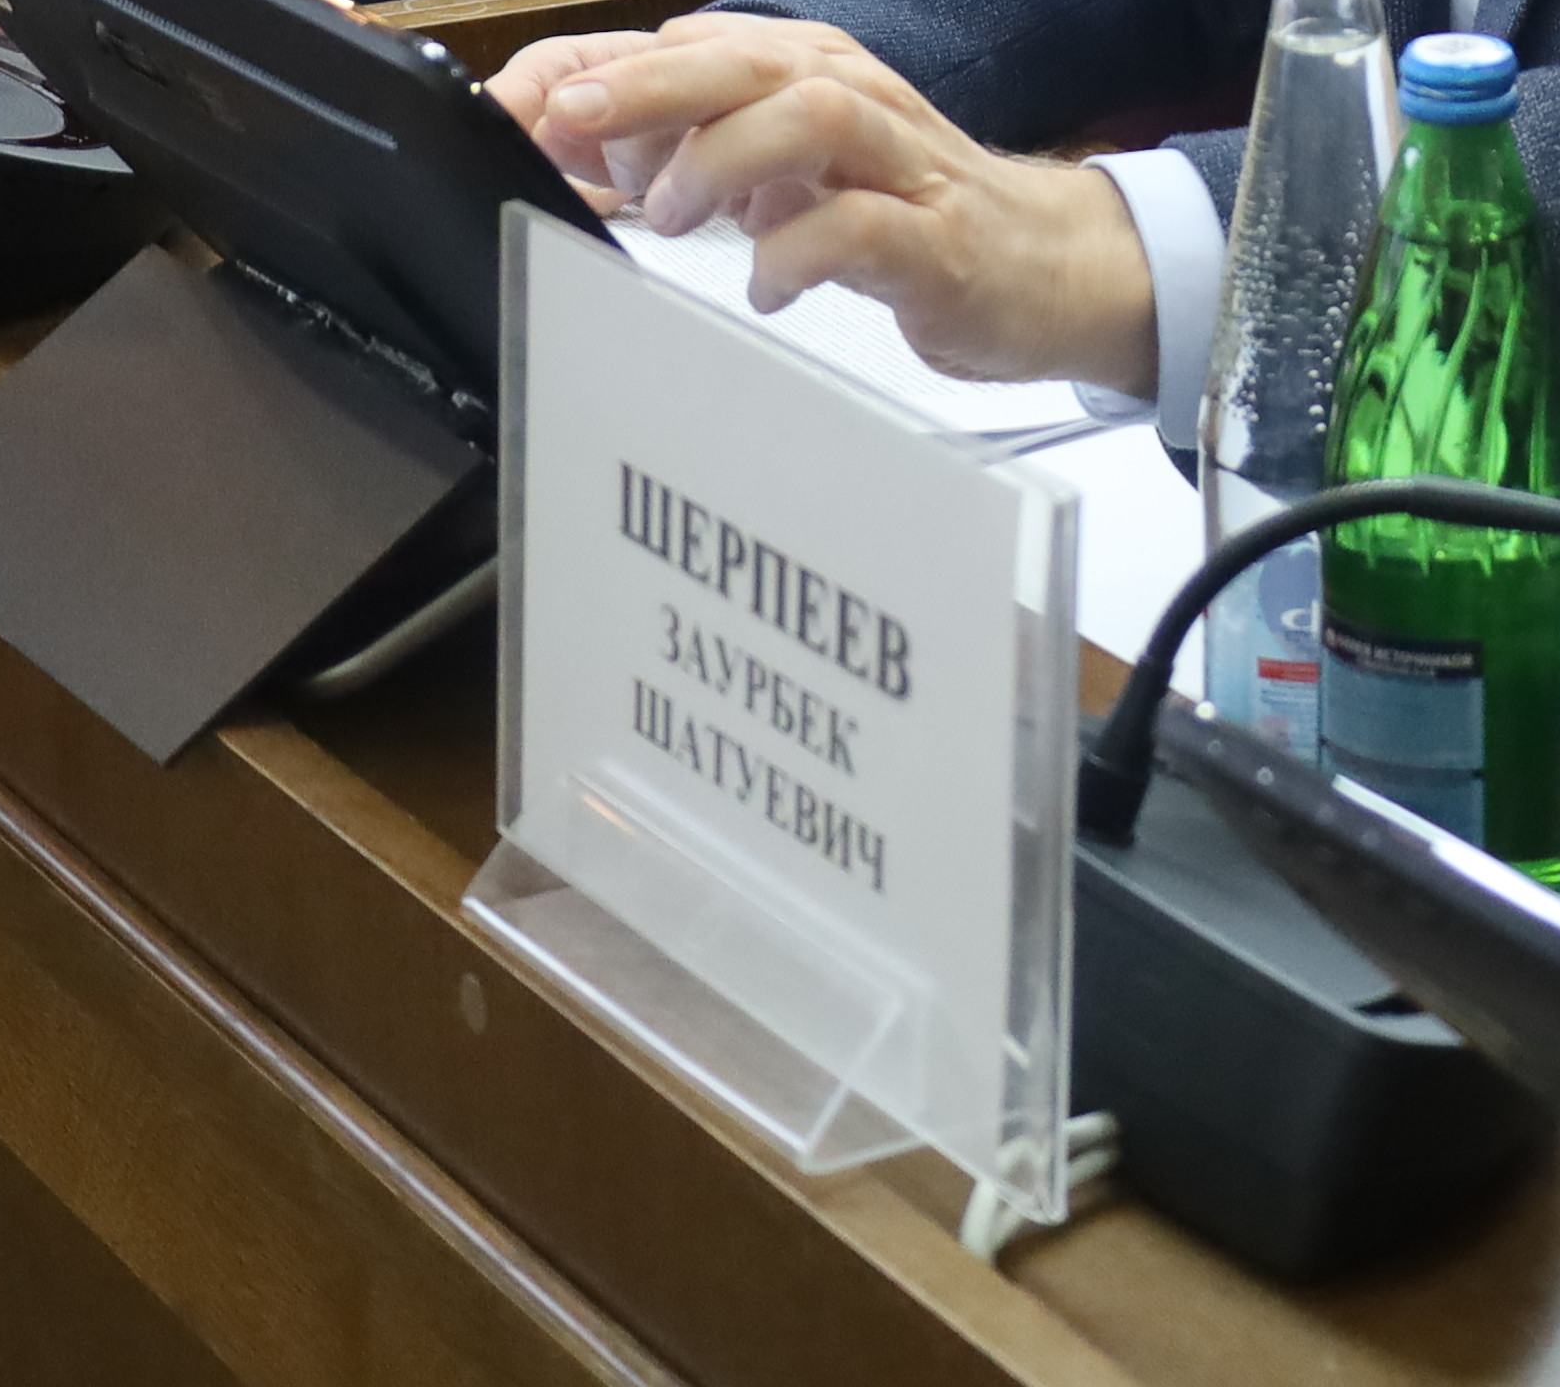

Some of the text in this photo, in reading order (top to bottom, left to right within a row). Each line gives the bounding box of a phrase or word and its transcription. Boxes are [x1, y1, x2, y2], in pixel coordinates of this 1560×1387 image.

[620, 461, 910, 701] ШЕРПЕЕВ
[660, 602, 859, 778] ЗАУРБЕК
[632, 678, 888, 897] ШАТУЕВИЧ
